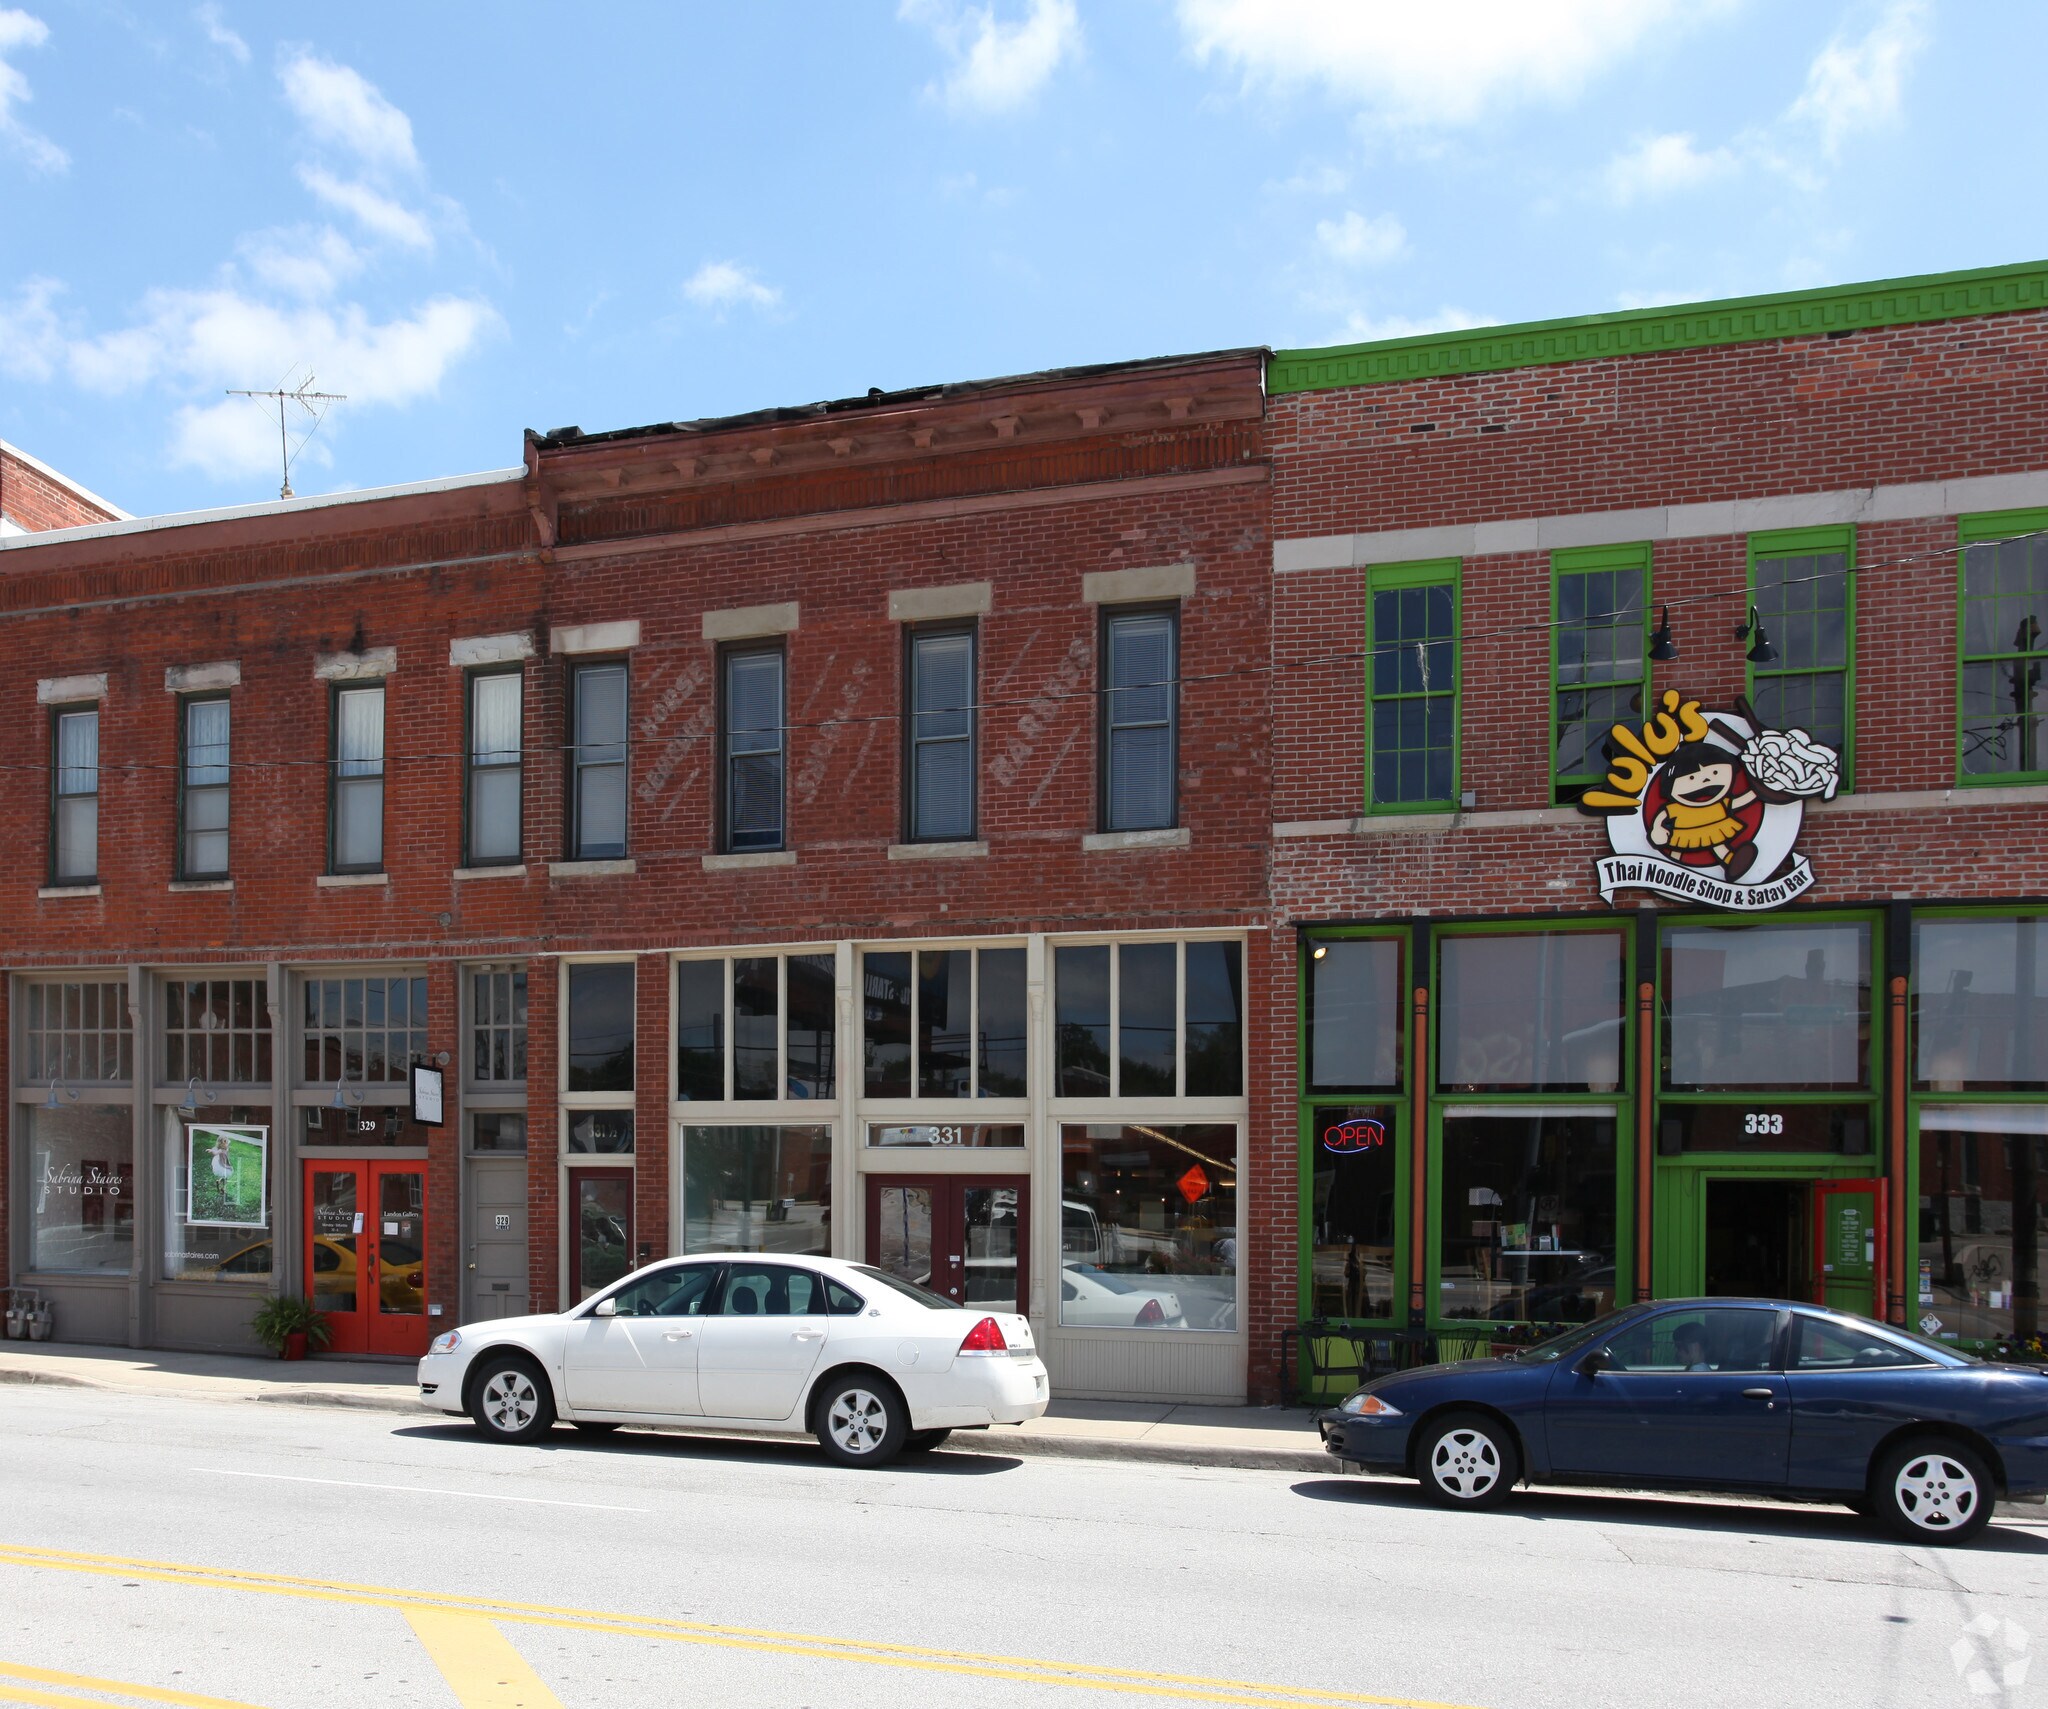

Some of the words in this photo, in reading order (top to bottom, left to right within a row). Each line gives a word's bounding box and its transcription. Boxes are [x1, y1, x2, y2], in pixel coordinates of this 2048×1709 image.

[1604, 861, 1643, 883] Thai
[1645, 864, 1697, 893] Noodle
[1697, 880, 1732, 905] Shop
[1734, 891, 1744, 905] &
[1748, 886, 1787, 906] Satay
[1785, 870, 1809, 893] Bar
[360, 1121, 375, 1130] 329
[588, 1124, 605, 1138] 331
[1745, 1114, 1783, 1134] 333
[929, 1126, 961, 1144] 331
[1325, 1126, 1383, 1146] OPEN
[47, 1164, 83, 1184] Sabrina
[87, 1167, 123, 1184] Staires
[44, 1186, 120, 1195] STUDIO
[497, 1216, 508, 1225] 329
